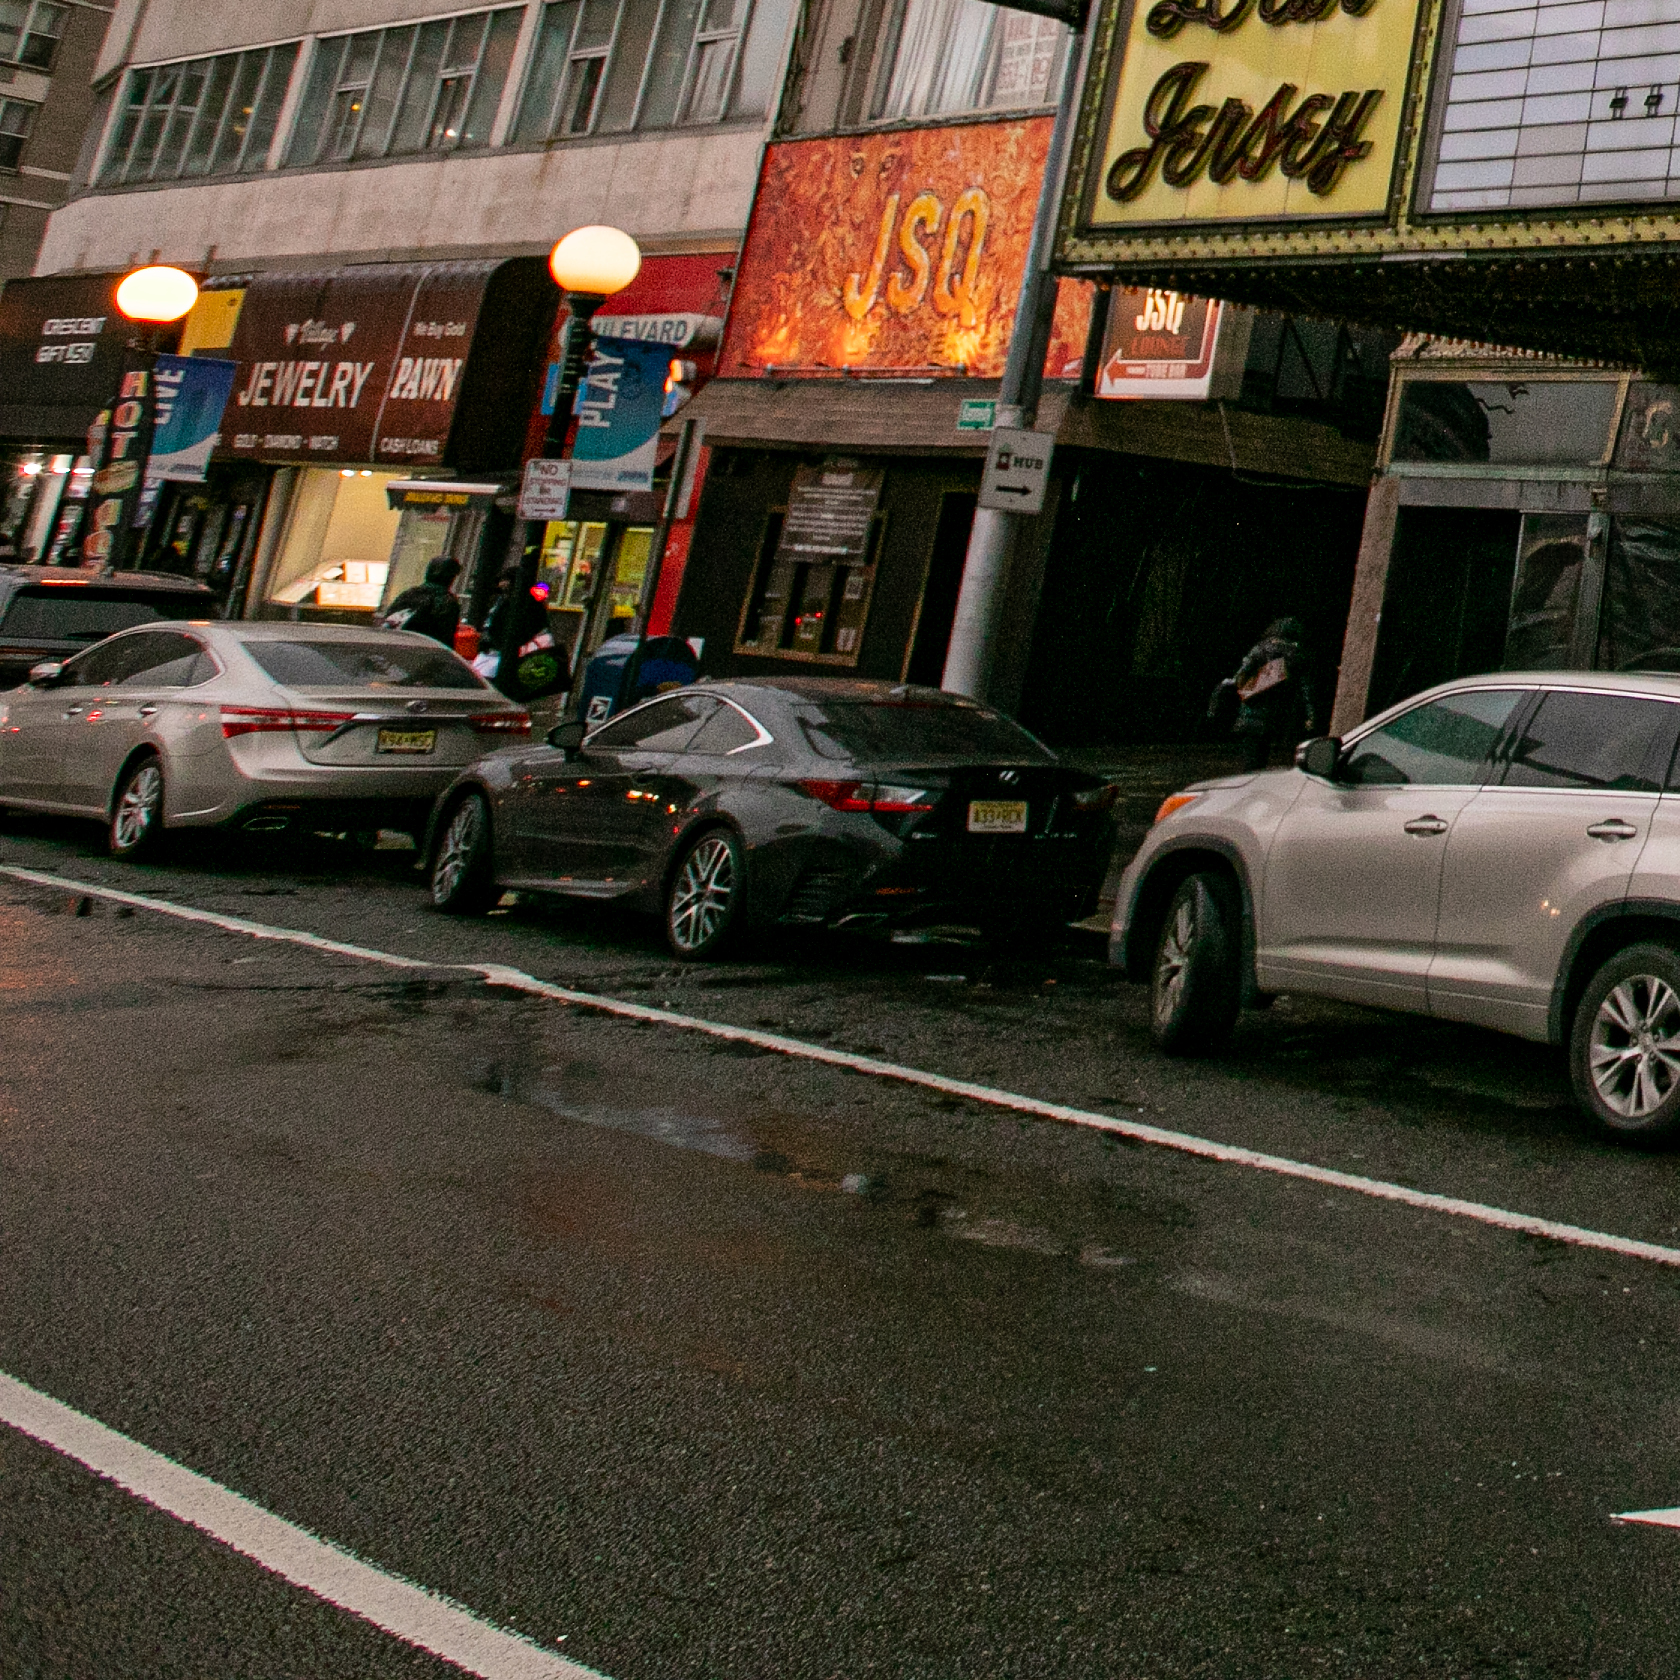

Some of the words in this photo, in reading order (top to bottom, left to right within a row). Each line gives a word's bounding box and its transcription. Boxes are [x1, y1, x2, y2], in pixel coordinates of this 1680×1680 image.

[1106, 61, 1385, 203] Jersey
[843, 186, 992, 328] JSQ
[1135, 287, 1186, 335] JSQ
[238, 361, 375, 408] JEWELRY
[389, 356, 463, 401] PAWN
[577, 340, 625, 429] PLAY
[110, 371, 148, 458] HOT
[540, 464, 558, 475] NO
[1013, 455, 1043, 470] HUB
